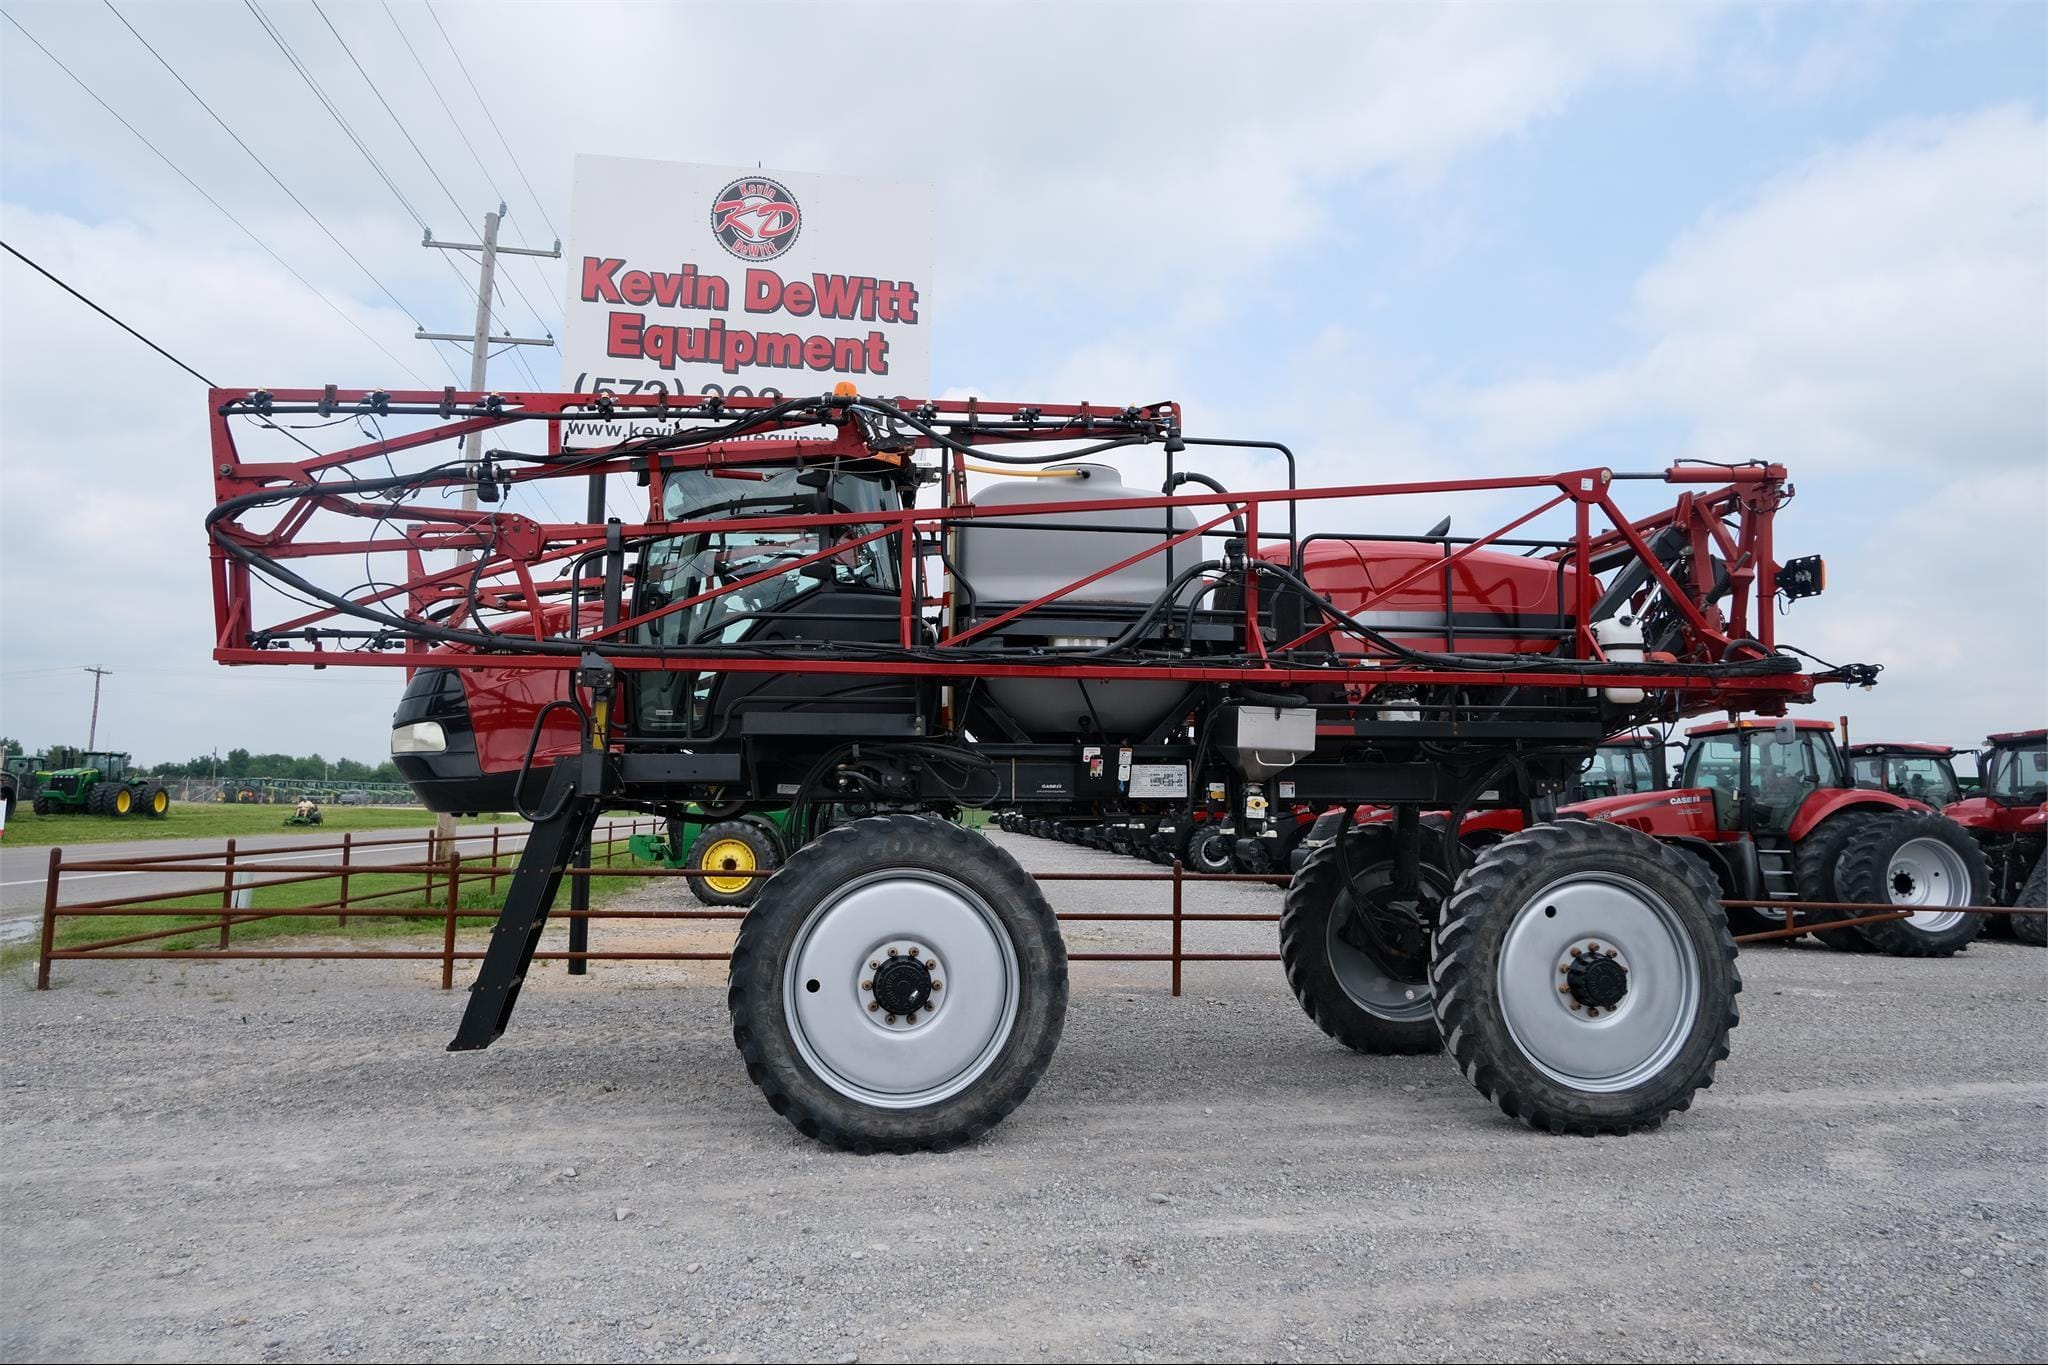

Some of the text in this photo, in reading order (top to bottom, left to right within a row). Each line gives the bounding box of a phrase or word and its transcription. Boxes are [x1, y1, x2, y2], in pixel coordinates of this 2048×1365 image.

[739, 182, 777, 198] Kevin
[714, 200, 799, 238] KD
[732, 239, 778, 257] DeWitt
[581, 256, 919, 325] Kevin DeWitt
[607, 311, 888, 376] Equipment
[1669, 796, 1692, 805] CASE
